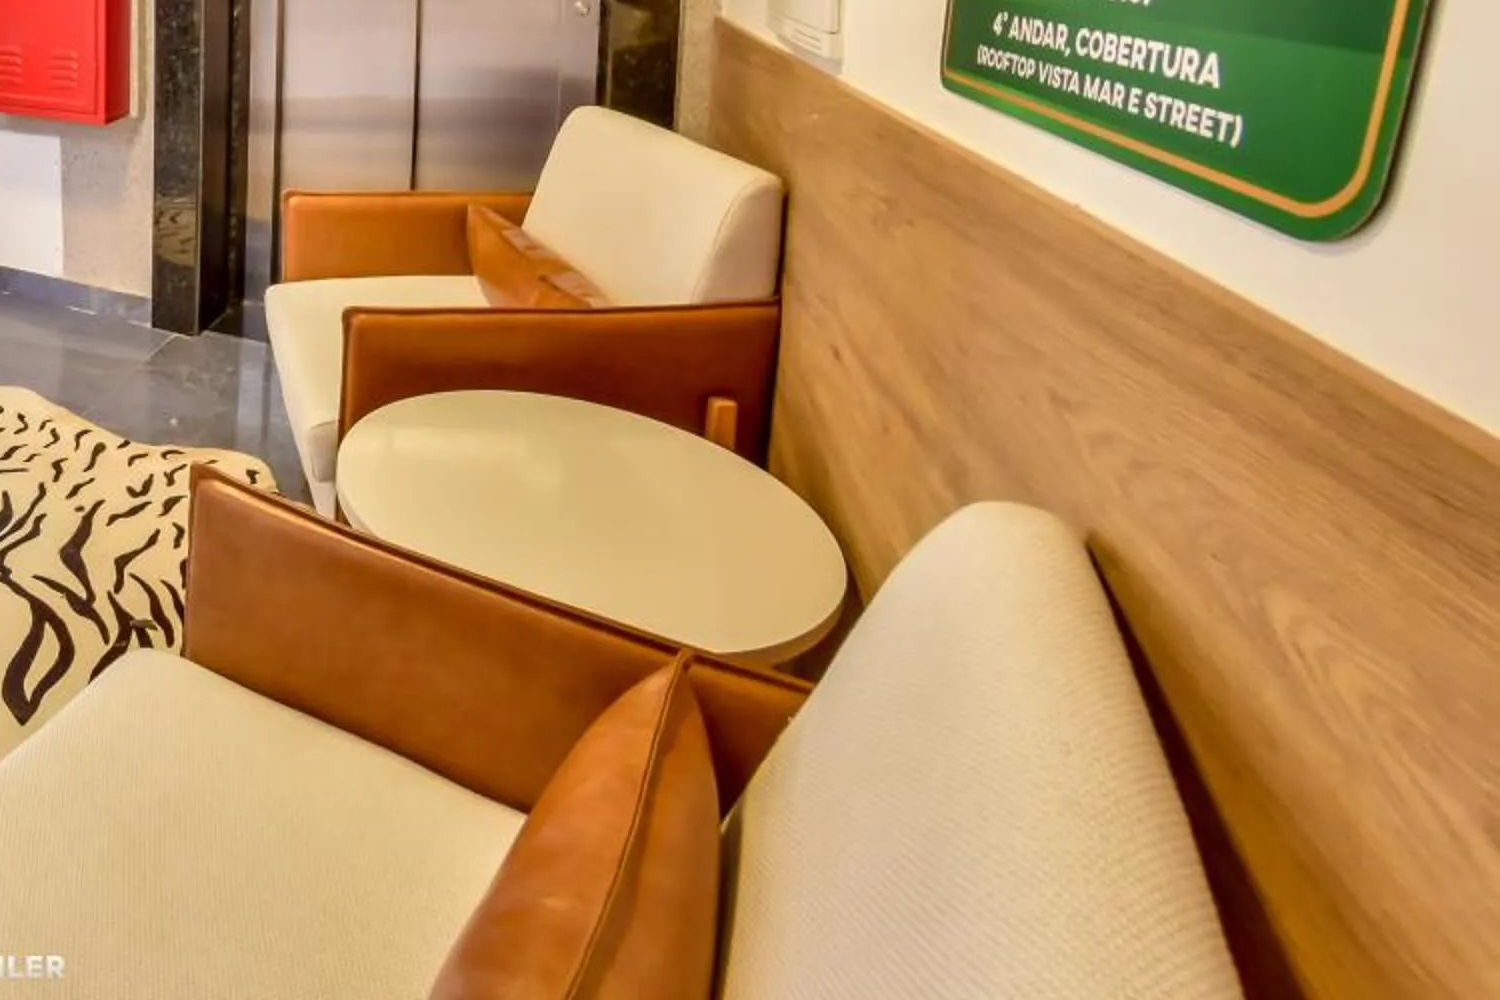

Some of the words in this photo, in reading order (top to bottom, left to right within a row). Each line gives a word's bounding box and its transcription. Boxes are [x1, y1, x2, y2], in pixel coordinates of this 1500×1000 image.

[977, 44, 1036, 80] (ROOFTOP
[1038, 63, 1080, 94] VISTA
[1083, 73, 1124, 109] MAR
[1127, 87, 1141, 114] E
[1144, 92, 1243, 148] STREET)
[1008, 16, 1071, 57] ANDAR,
[1075, 27, 1220, 88] COBERTURA
